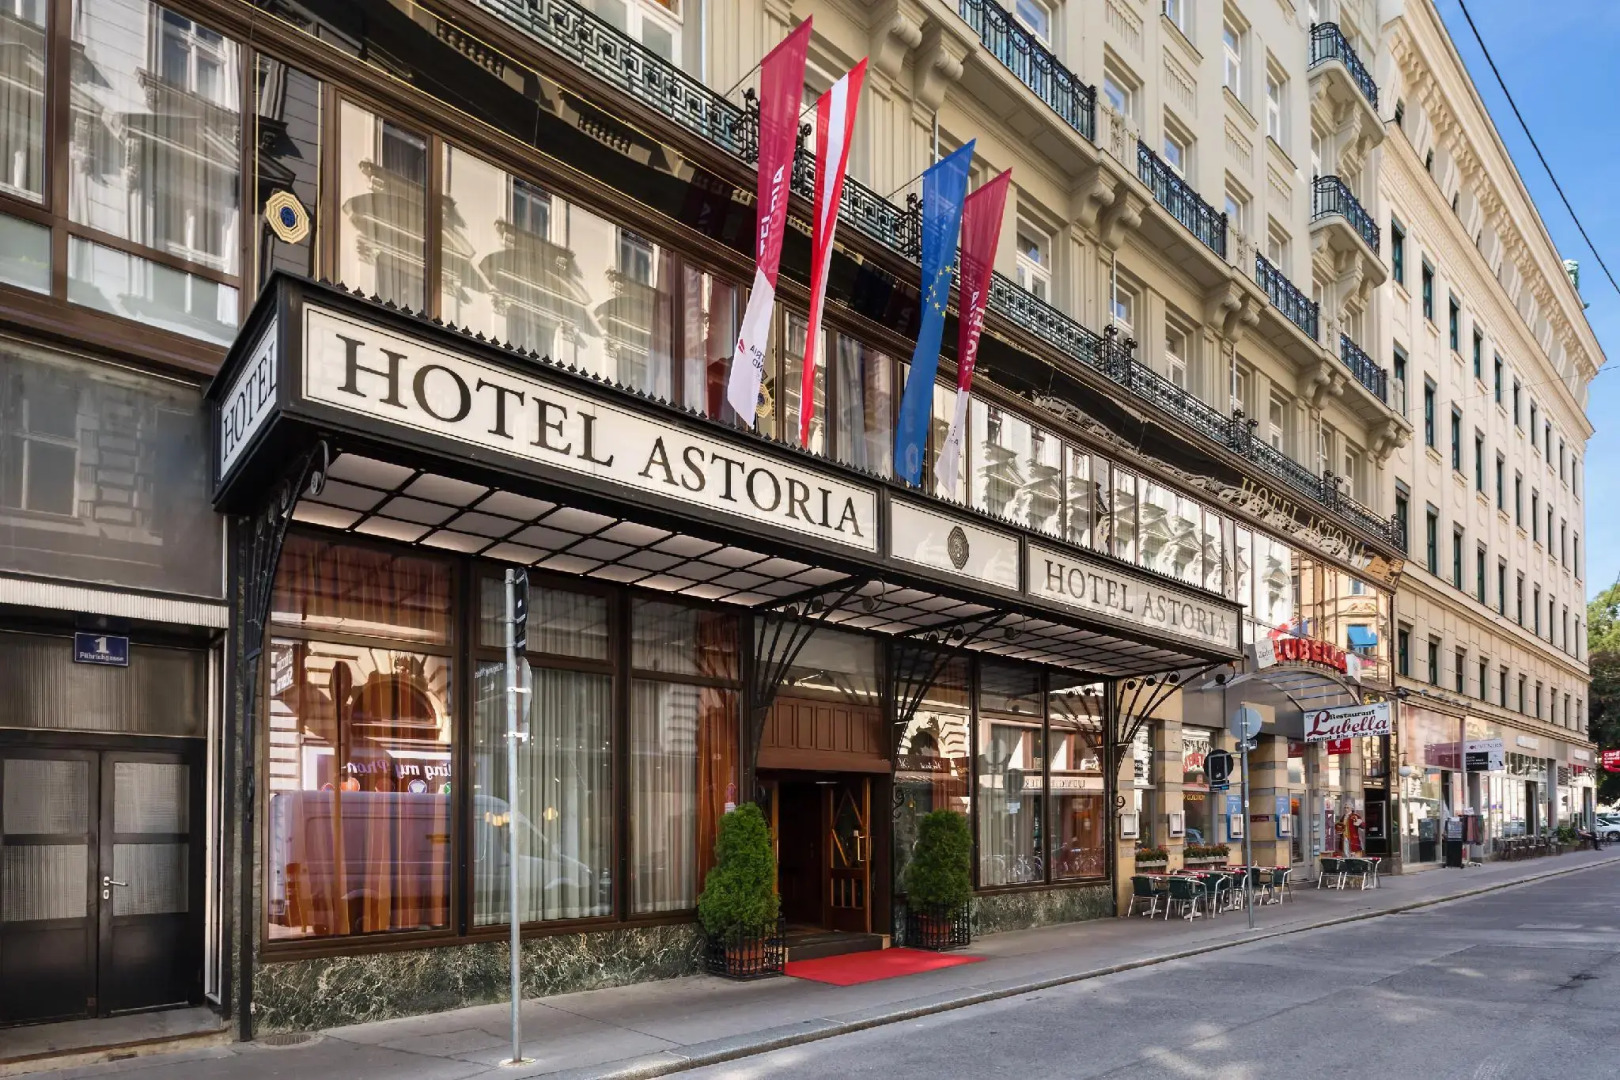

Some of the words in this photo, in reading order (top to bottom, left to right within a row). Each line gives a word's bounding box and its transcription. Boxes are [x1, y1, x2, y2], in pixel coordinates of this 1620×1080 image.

[222, 340, 277, 463] HOTEL
[335, 333, 614, 468] HOTEL
[637, 436, 864, 538] ASTORIA
[1237, 476, 1299, 533] HOTEL
[1306, 516, 1366, 571] ASTORIA
[1044, 559, 1134, 614] HOTEL
[1141, 592, 1229, 641] ASTORIA
[95, 636, 110, 654] 1
[1273, 638, 1348, 674] LUBELLA
[1306, 710, 1389, 738] Lubella
[1329, 709, 1376, 720] Restaurant
